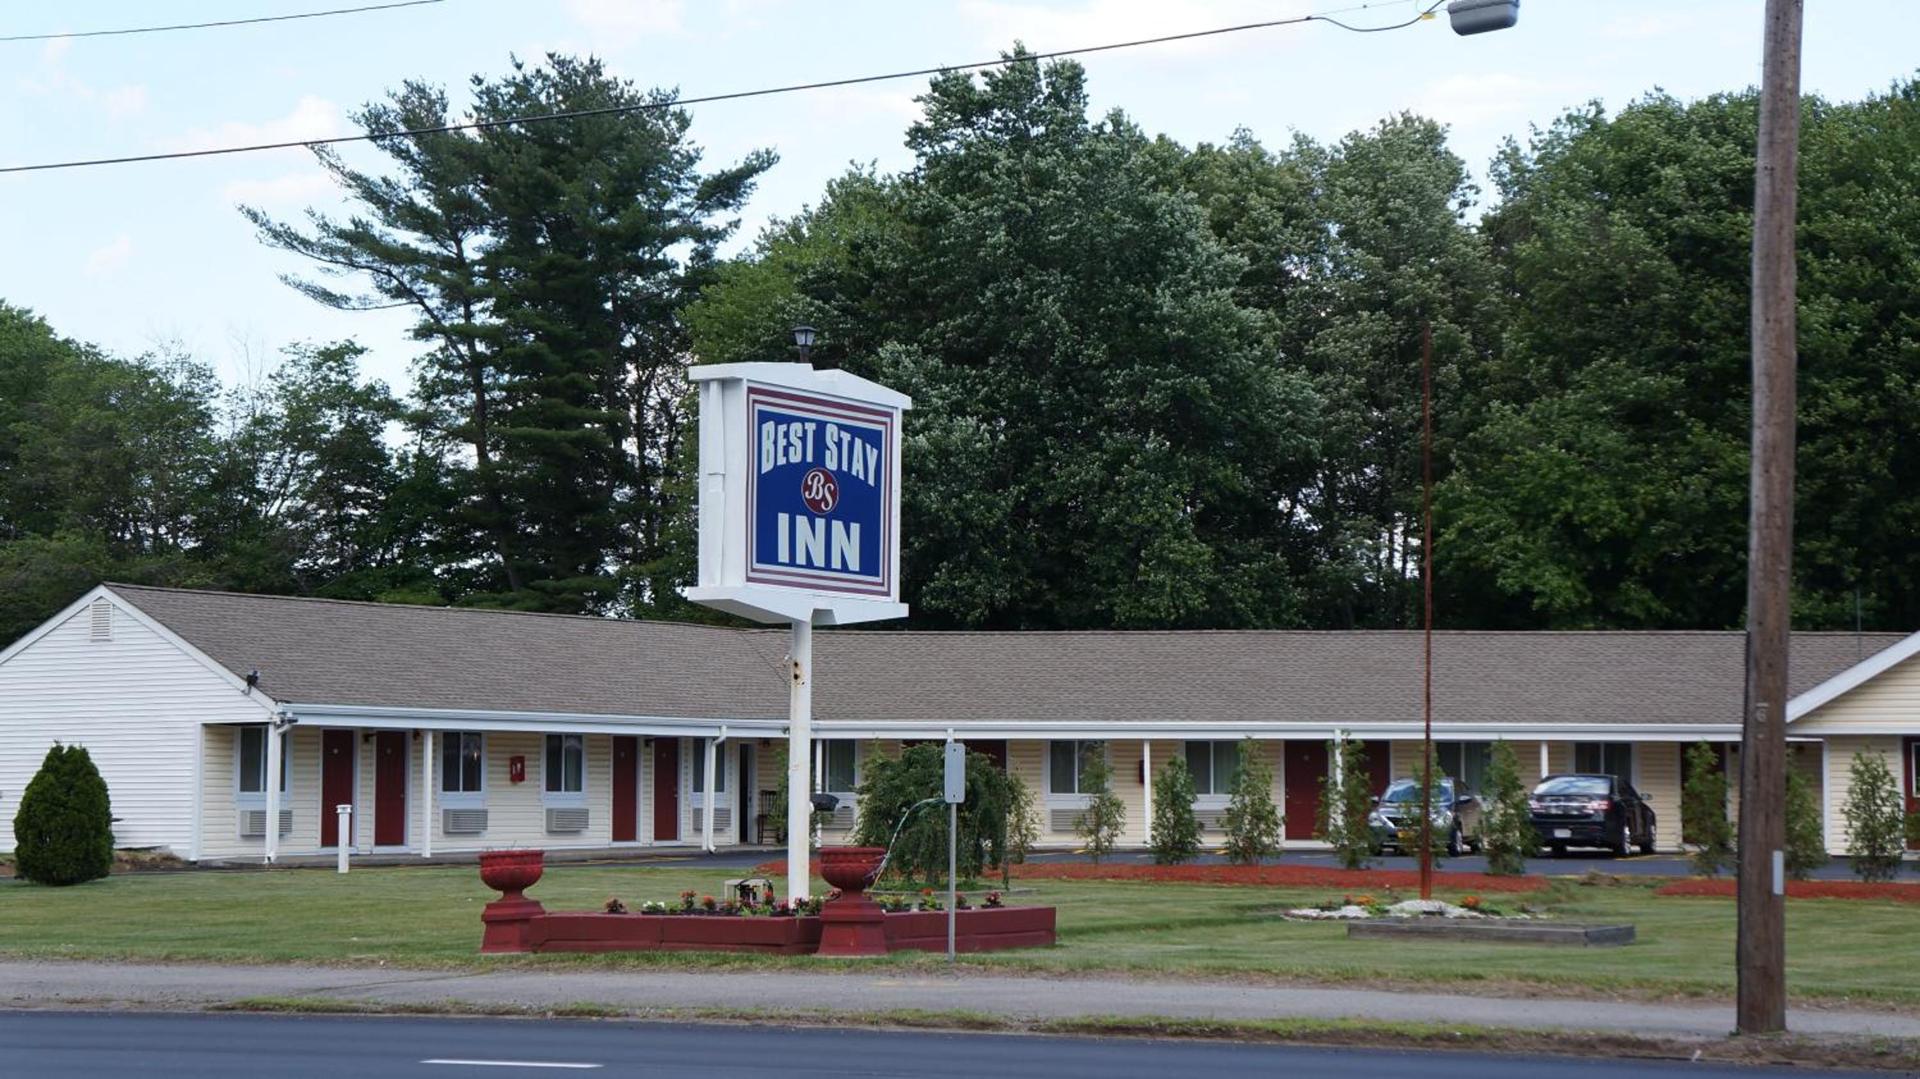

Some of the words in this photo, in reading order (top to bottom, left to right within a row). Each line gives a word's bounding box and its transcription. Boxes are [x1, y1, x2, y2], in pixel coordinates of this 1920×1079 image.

[761, 421, 816, 474] BEST
[825, 423, 879, 487] STAY
[805, 471, 834, 511] BS
[778, 512, 860, 572] INN
